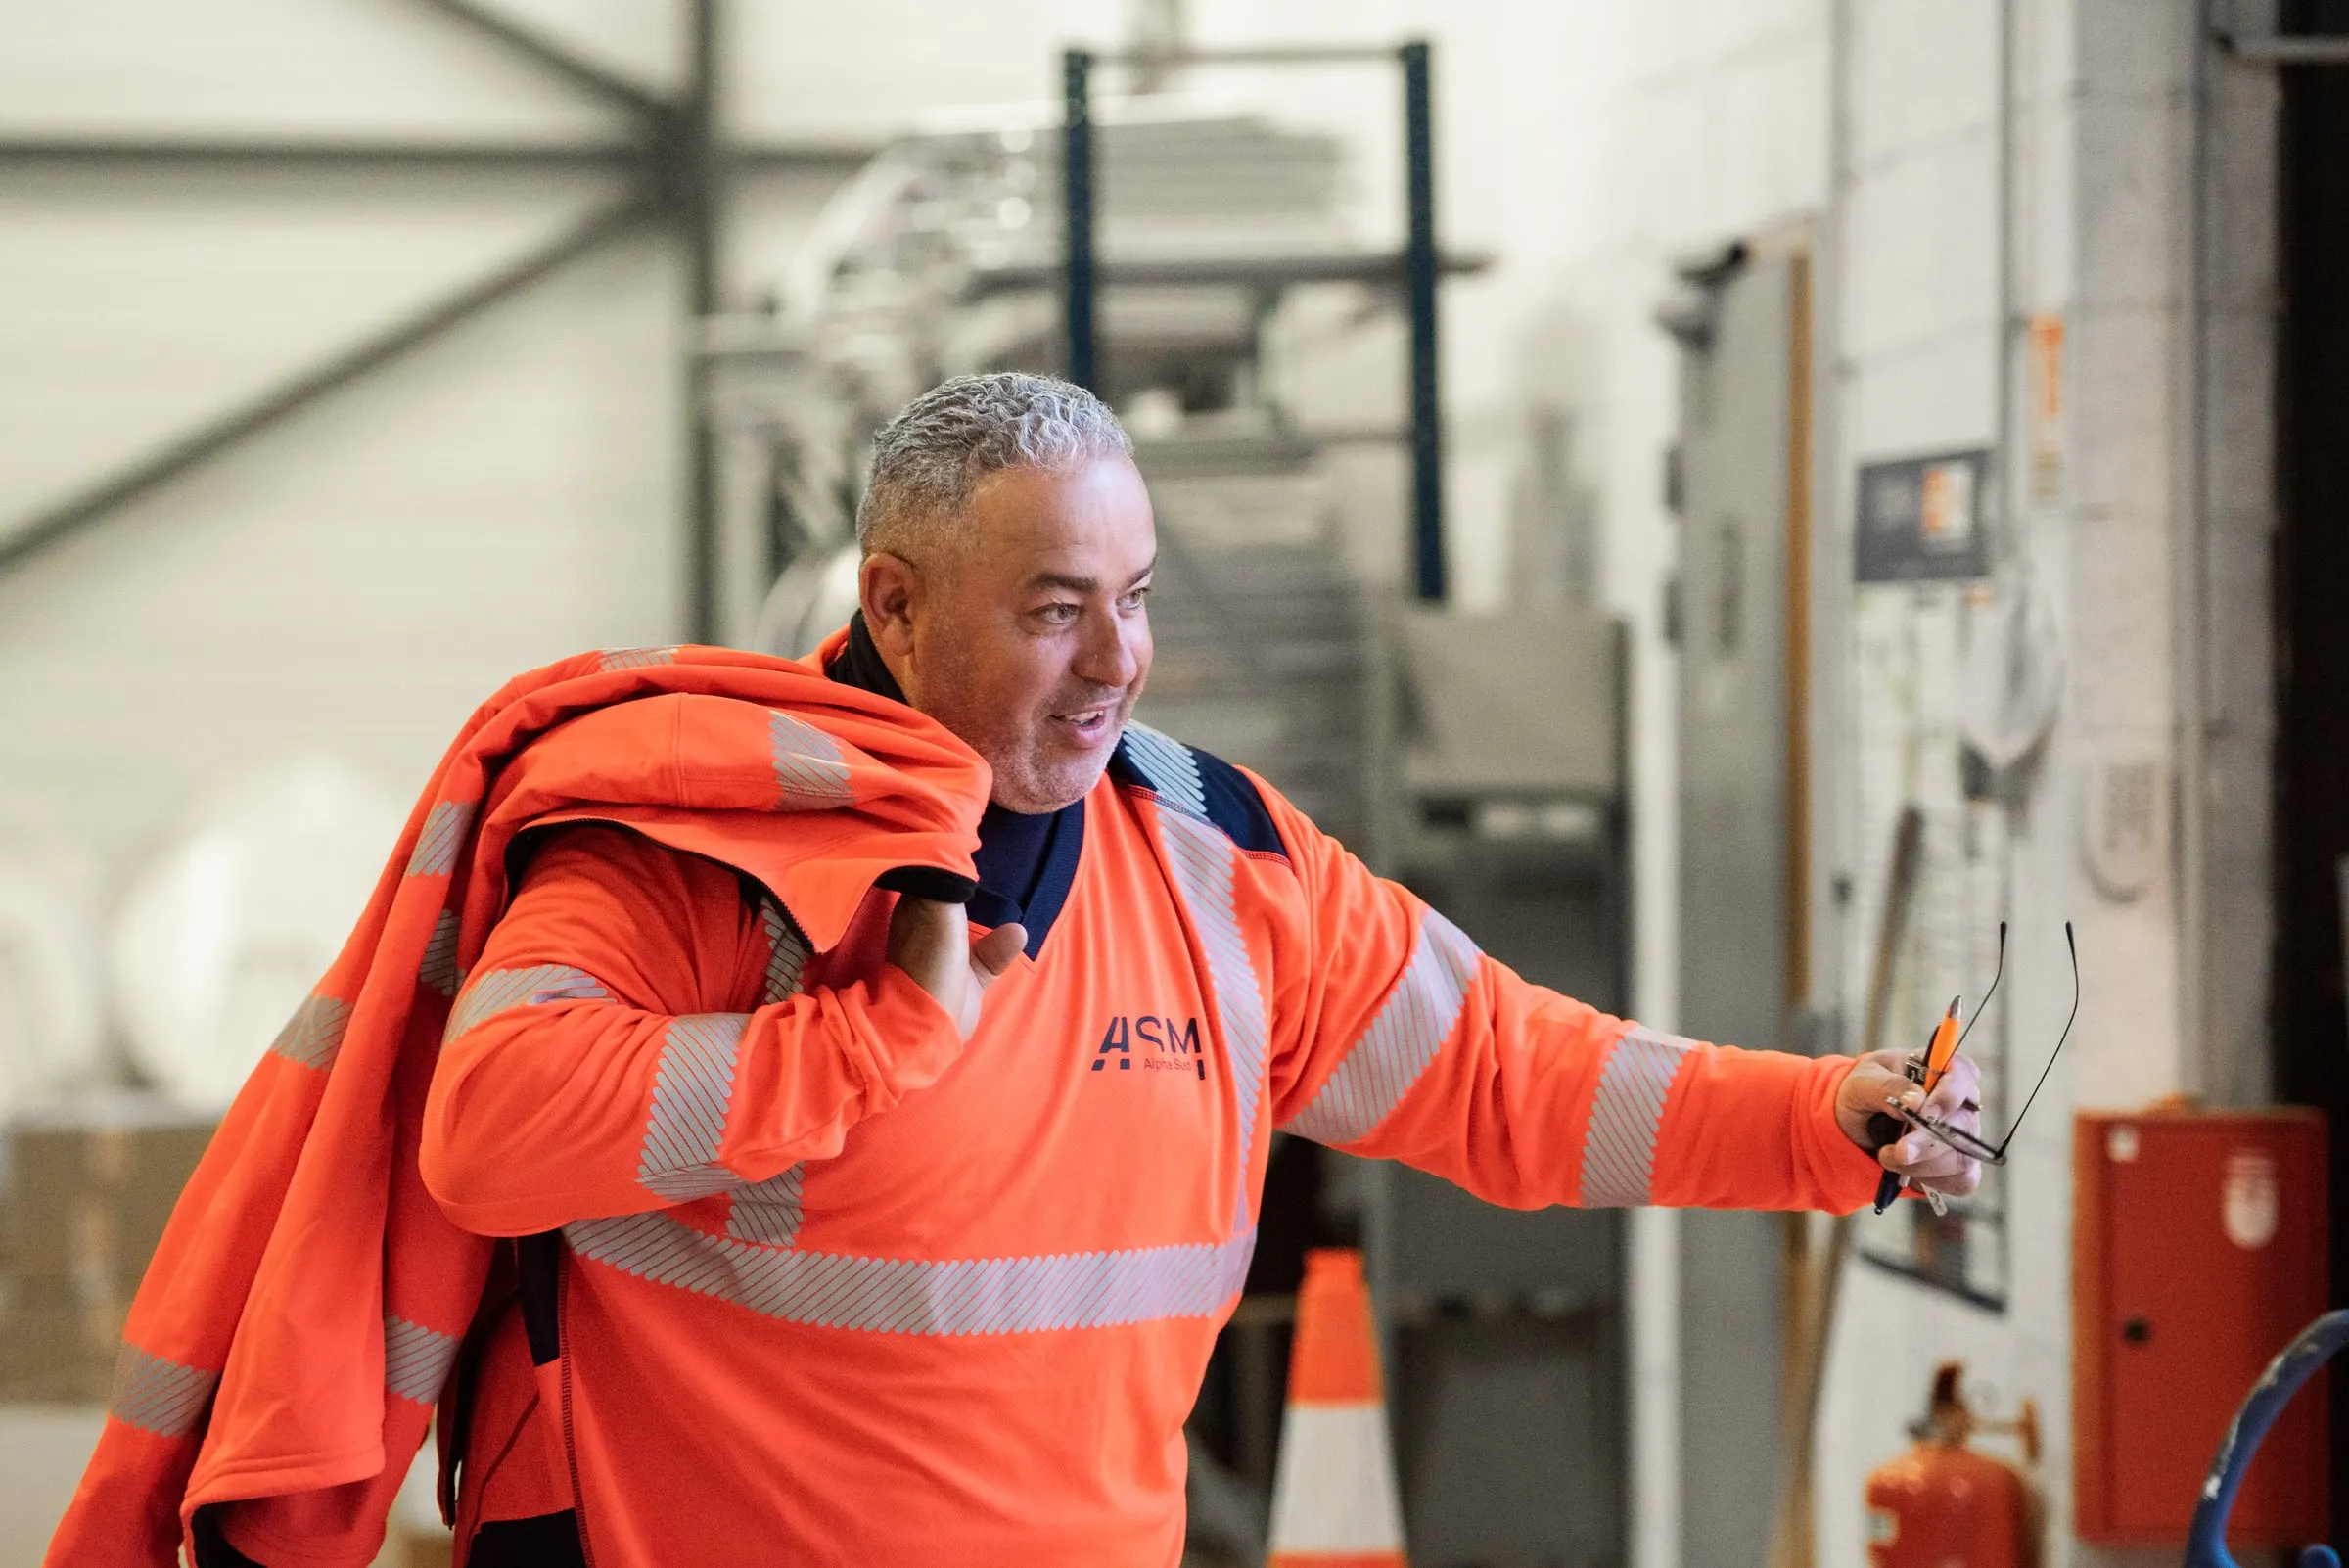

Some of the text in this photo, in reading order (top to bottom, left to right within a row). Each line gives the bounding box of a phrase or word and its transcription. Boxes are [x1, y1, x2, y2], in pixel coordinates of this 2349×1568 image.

[1091, 1016, 1205, 1080] ASM
[1143, 1057, 1192, 1072] Alpha Sud
